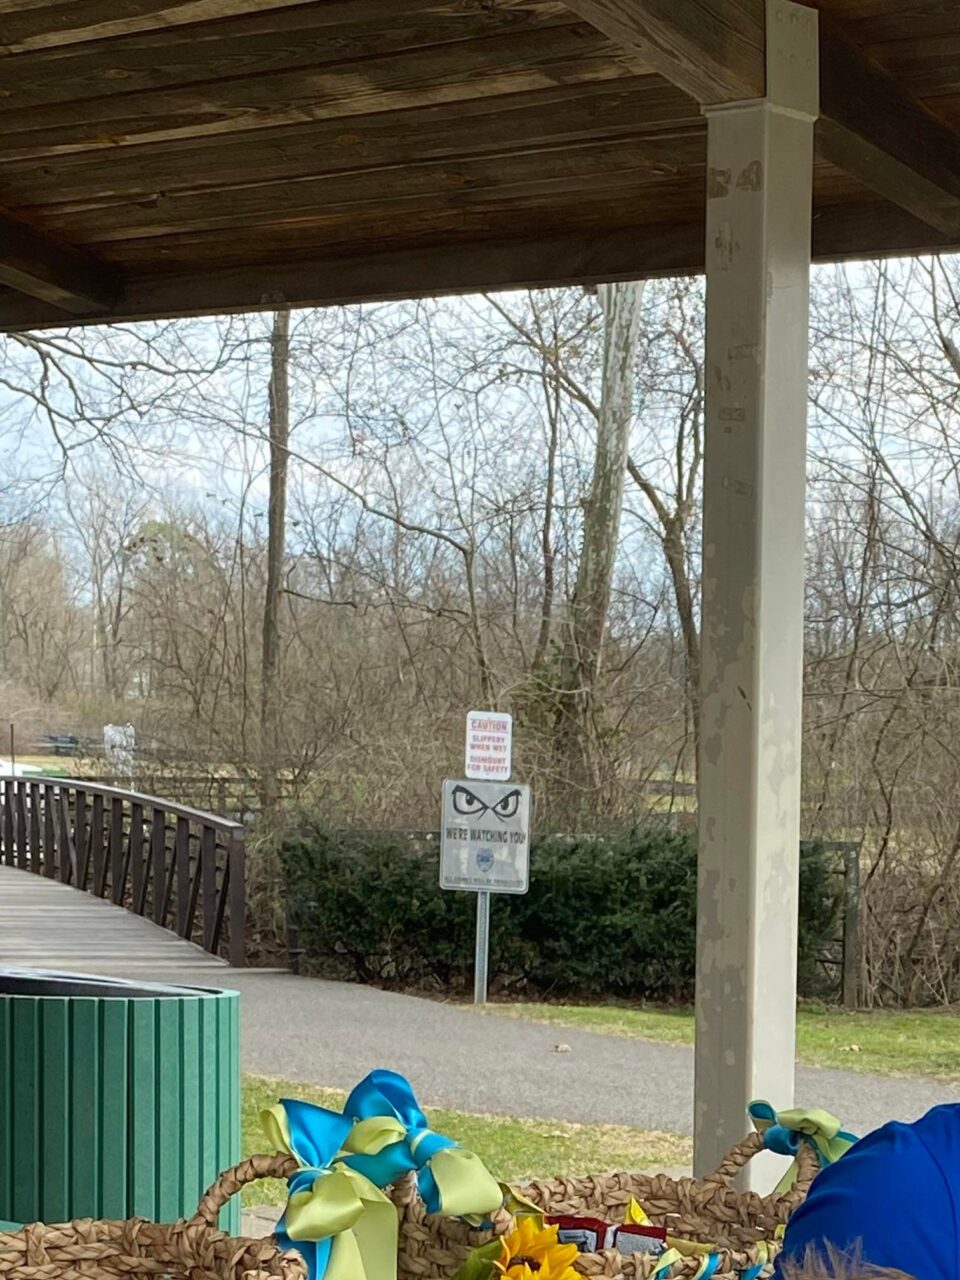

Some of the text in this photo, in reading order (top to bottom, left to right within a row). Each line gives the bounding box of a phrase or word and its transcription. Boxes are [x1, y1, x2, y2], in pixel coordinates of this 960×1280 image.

[471, 719, 507, 731] CAUTION
[467, 763, 508, 773] FOR SAFETY
[470, 829, 508, 843] WATCHING
